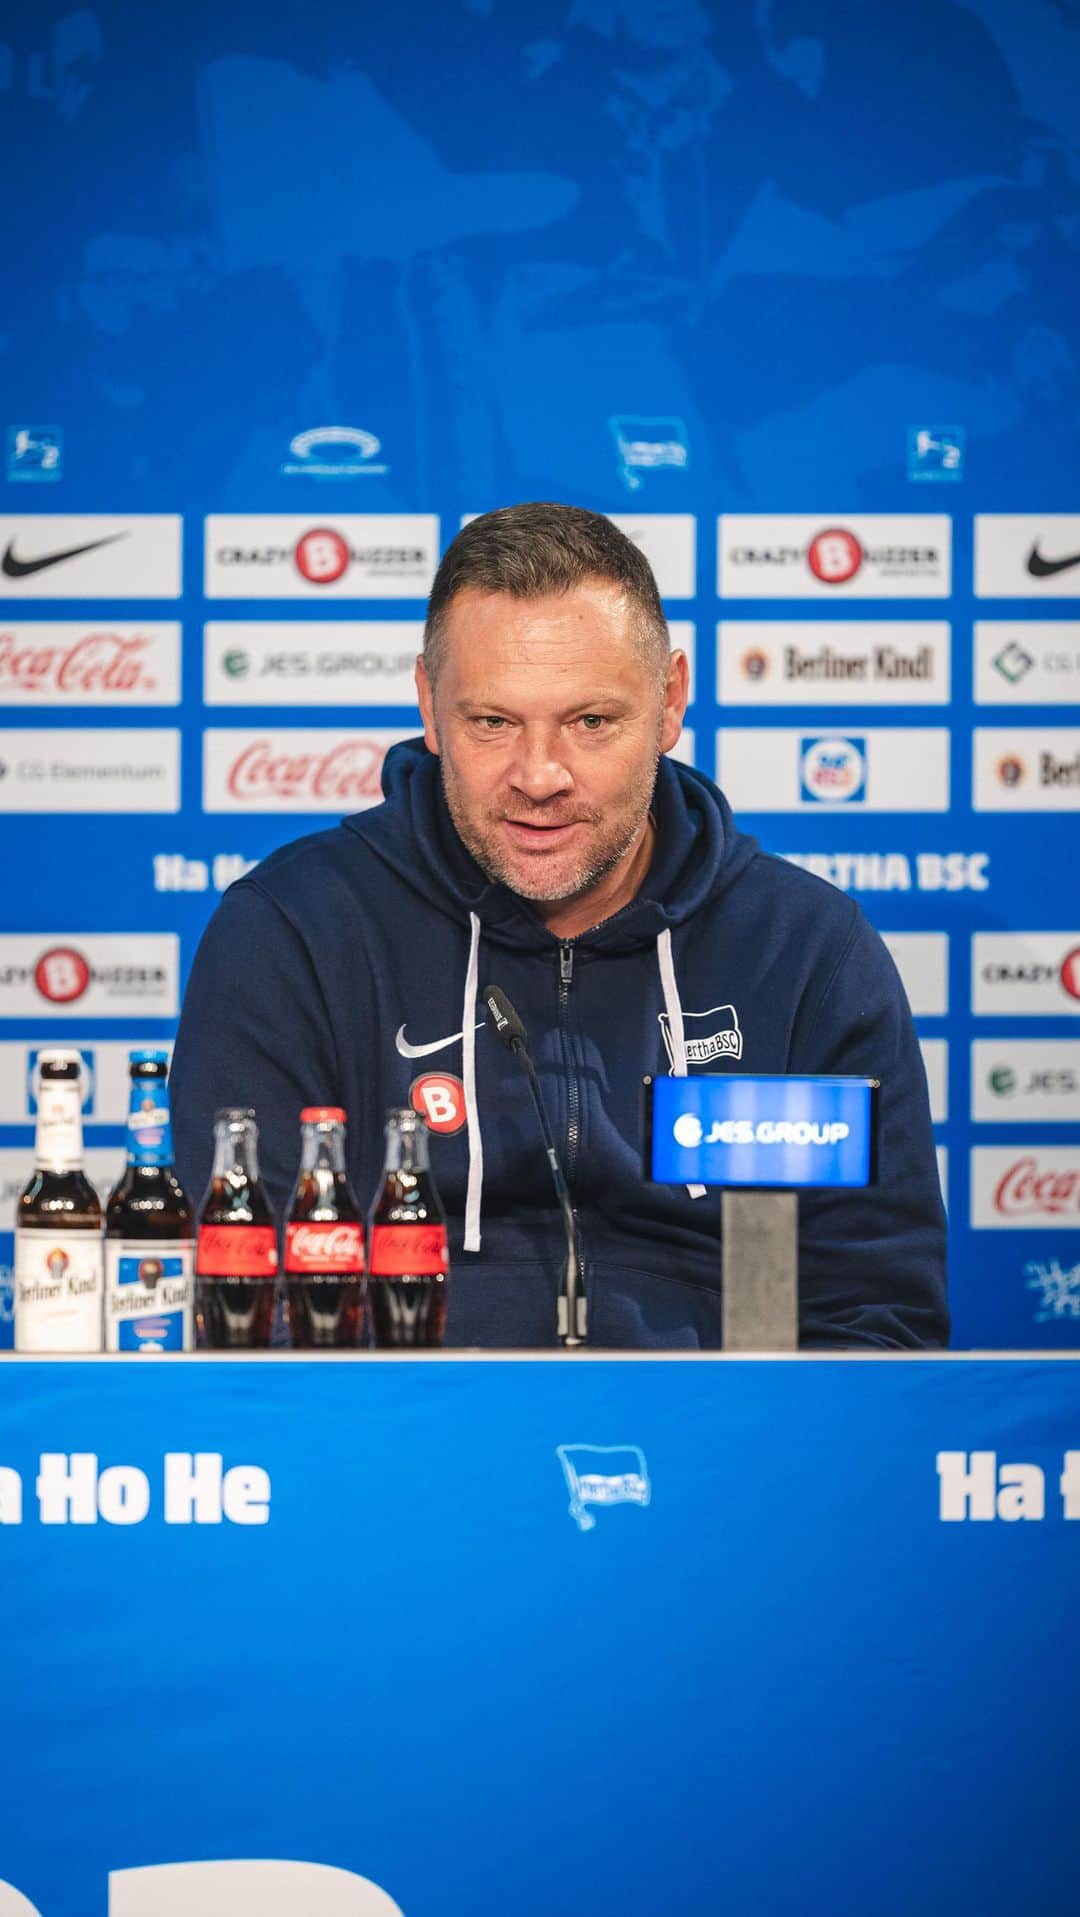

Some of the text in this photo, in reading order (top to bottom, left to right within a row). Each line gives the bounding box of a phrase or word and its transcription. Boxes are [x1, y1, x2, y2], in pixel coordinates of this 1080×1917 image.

[785, 645, 932, 681] Berliner Kindl
[154, 854, 208, 891] Ha
[917, 854, 989, 891] BSC
[422, 1086, 457, 1123] B
[755, 1121, 850, 1145] GROUP
[37, 1452, 150, 1525] Ho
[164, 1452, 271, 1525] He
[936, 1451, 1045, 1522] Ha
